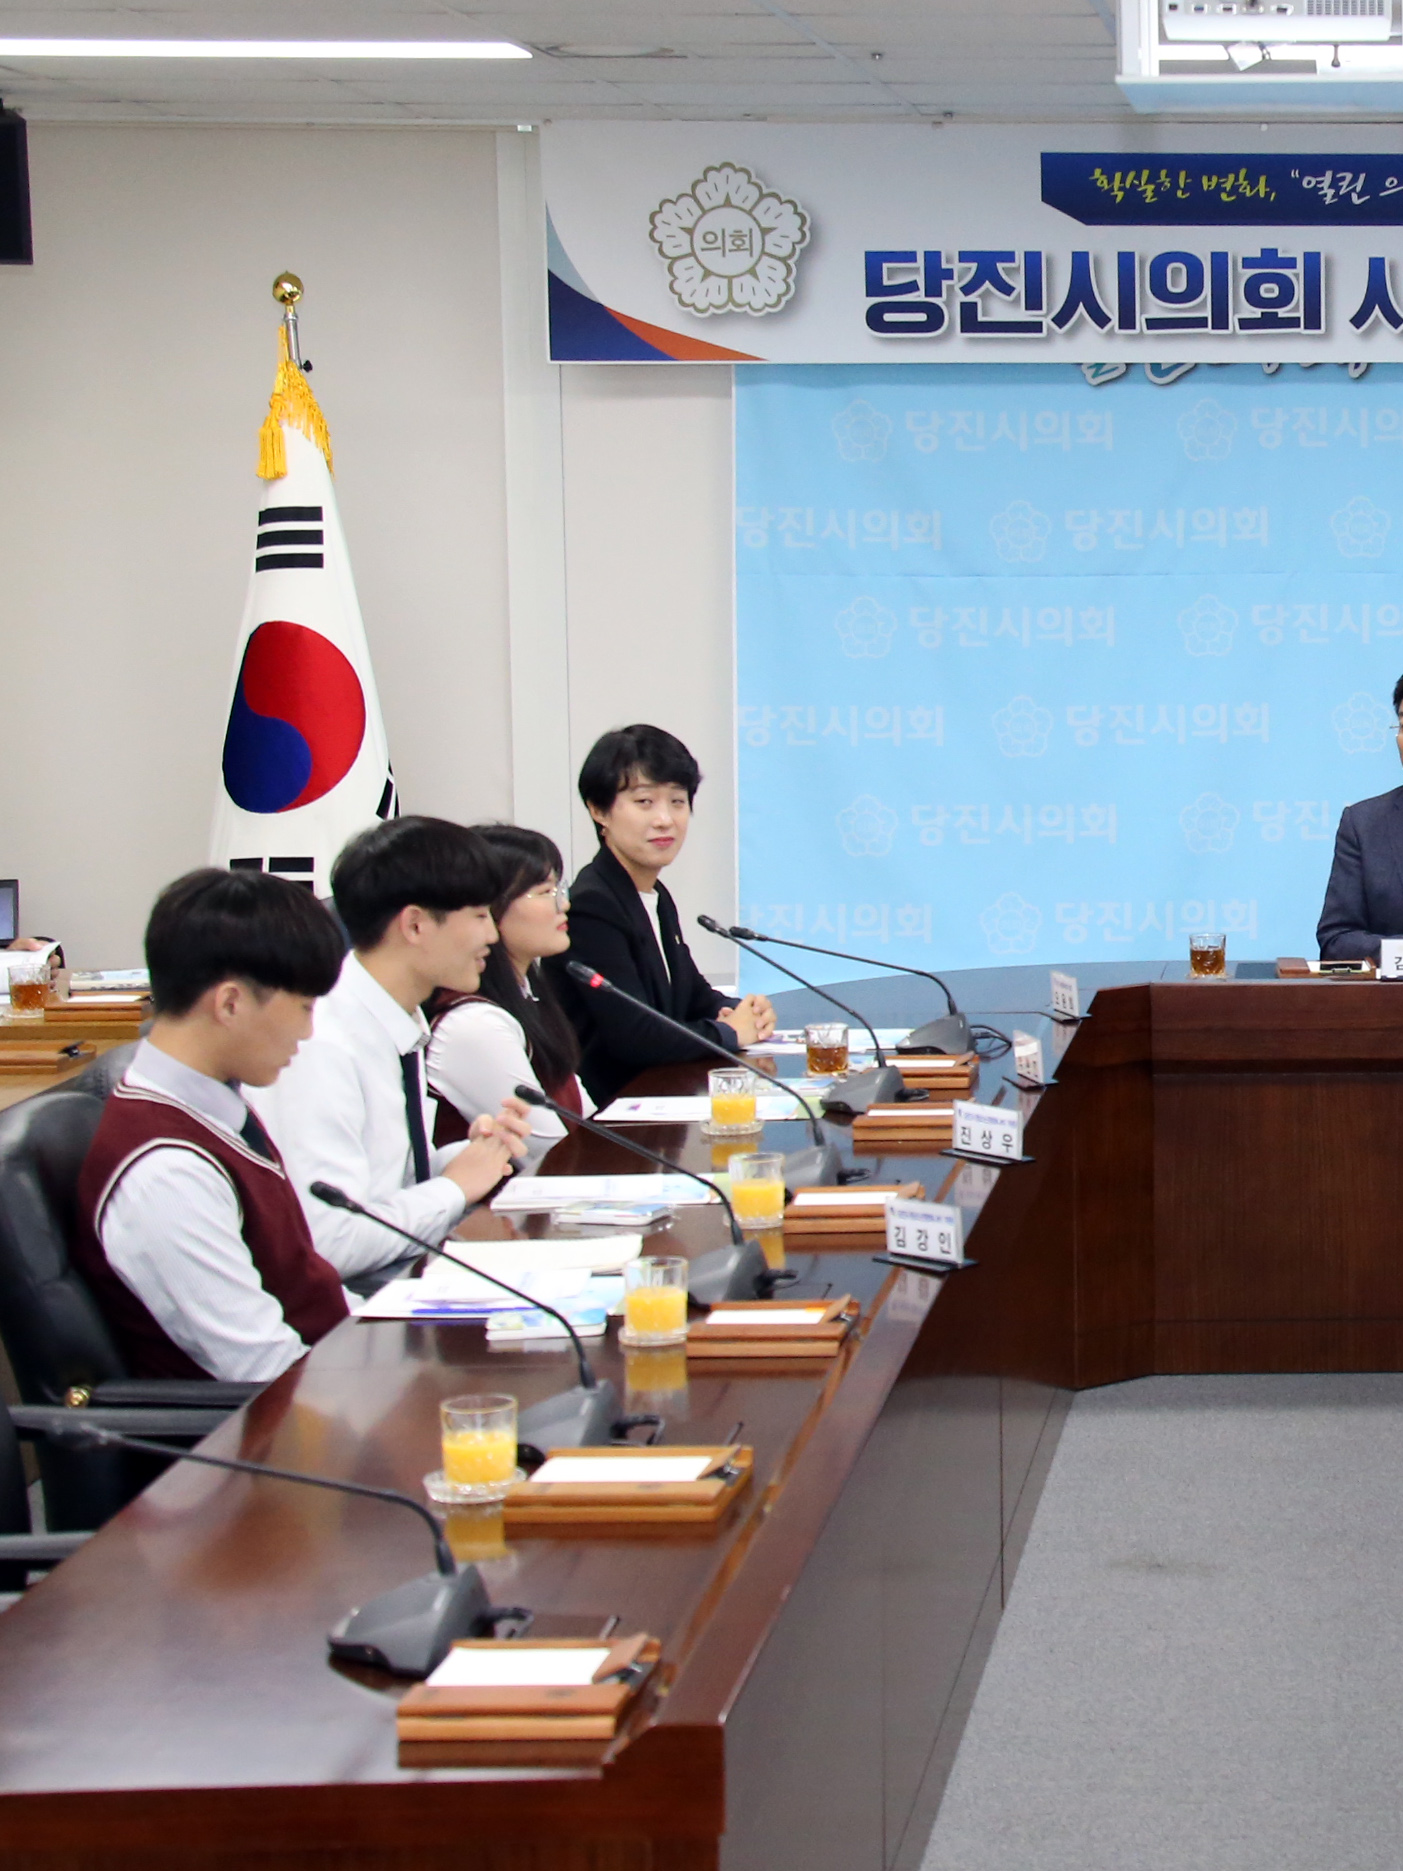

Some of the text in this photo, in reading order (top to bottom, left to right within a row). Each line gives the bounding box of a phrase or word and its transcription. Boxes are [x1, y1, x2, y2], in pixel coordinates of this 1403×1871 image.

[1089, 168, 1192, 203] 확실한
[1202, 168, 1276, 201] 변화,
[701, 228, 754, 257] 의회
[863, 247, 1324, 335] 당진시의회
[905, 408, 1114, 454] 당진시의회
[736, 505, 943, 551] 당진시의회
[1064, 505, 1271, 552] 당진시의회
[908, 604, 1117, 650] 당진시의회
[738, 704, 946, 748] 당진시의회
[1065, 701, 1271, 746] 당진시의회
[910, 803, 1118, 848] 당진시의회
[1054, 898, 1259, 943] 당진시의회
